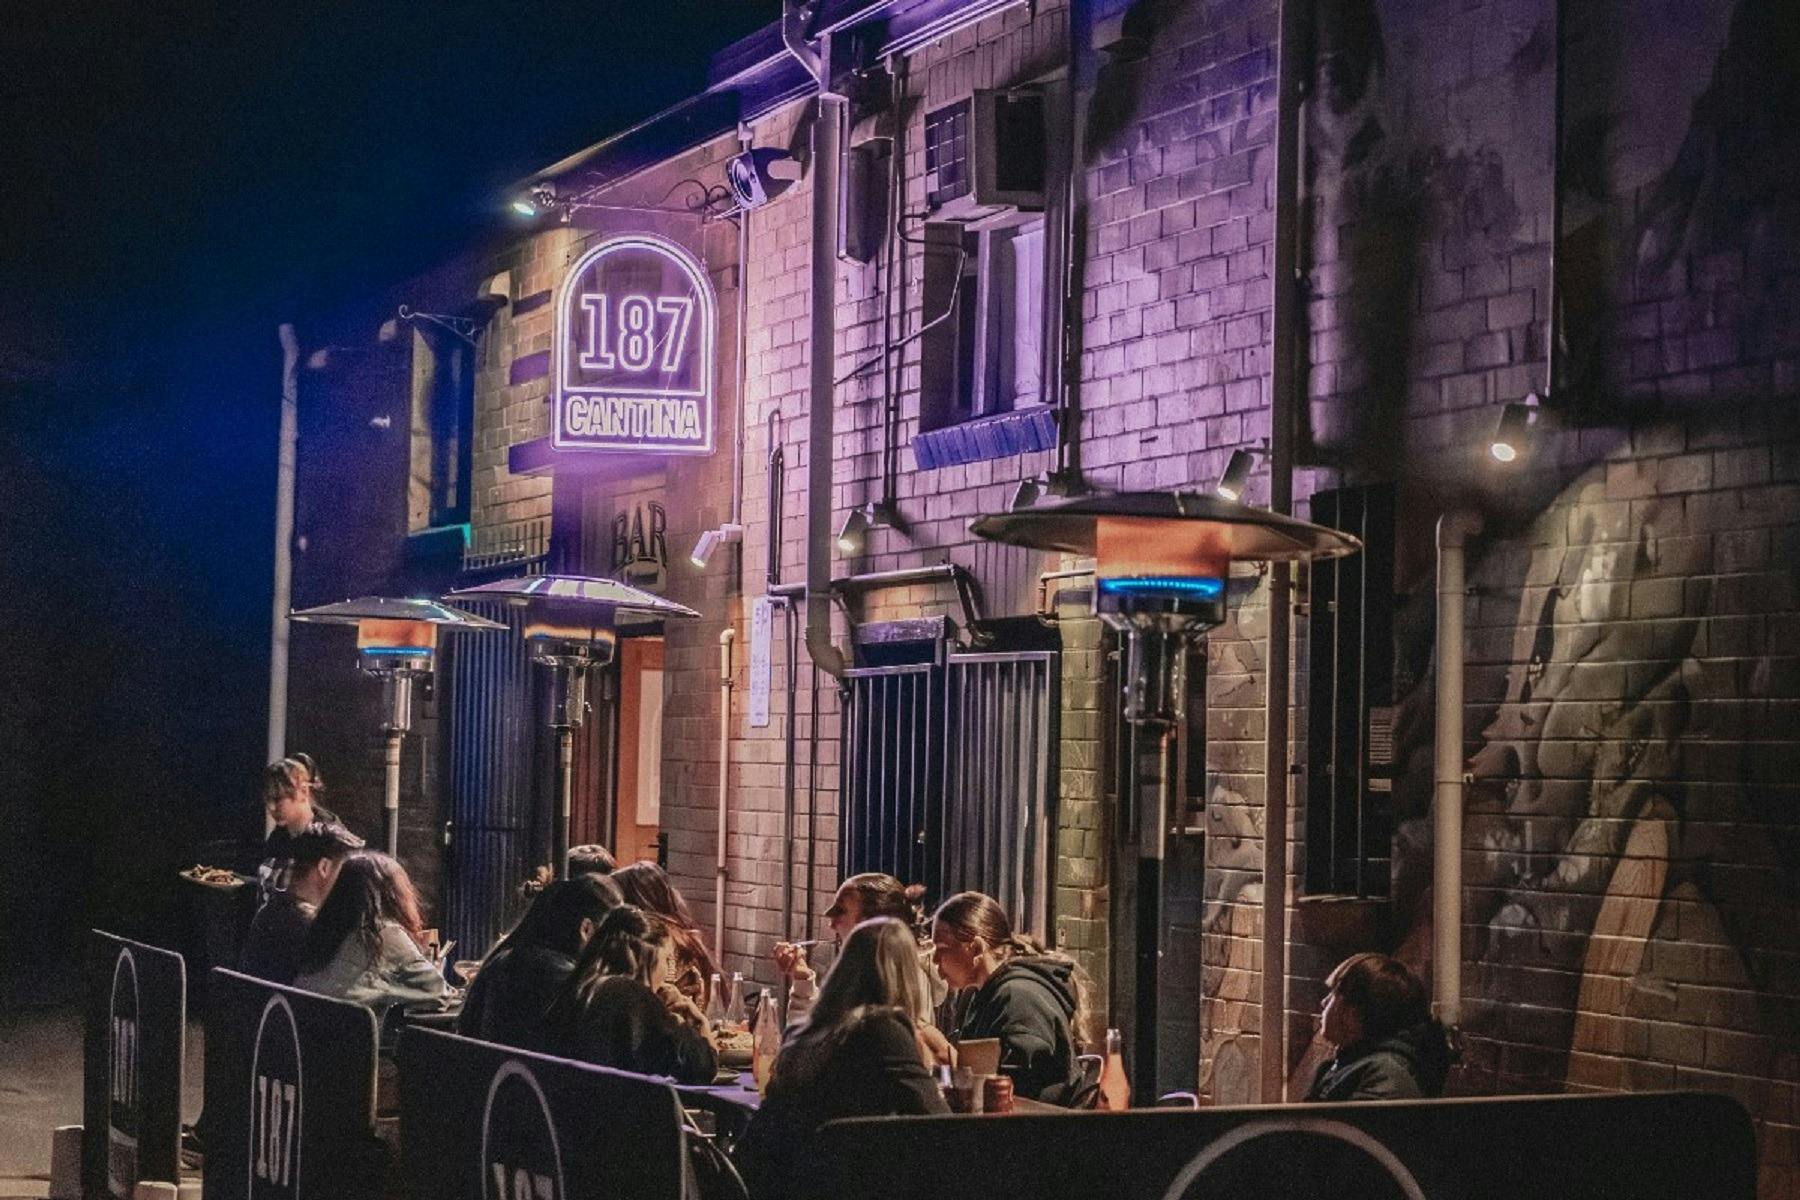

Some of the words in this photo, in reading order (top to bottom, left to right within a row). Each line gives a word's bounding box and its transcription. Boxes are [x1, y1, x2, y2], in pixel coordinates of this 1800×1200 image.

[579, 293, 694, 372] 187
[566, 395, 702, 439] CANTINA
[610, 500, 668, 573] BAR
[256, 1075, 295, 1187] 187
